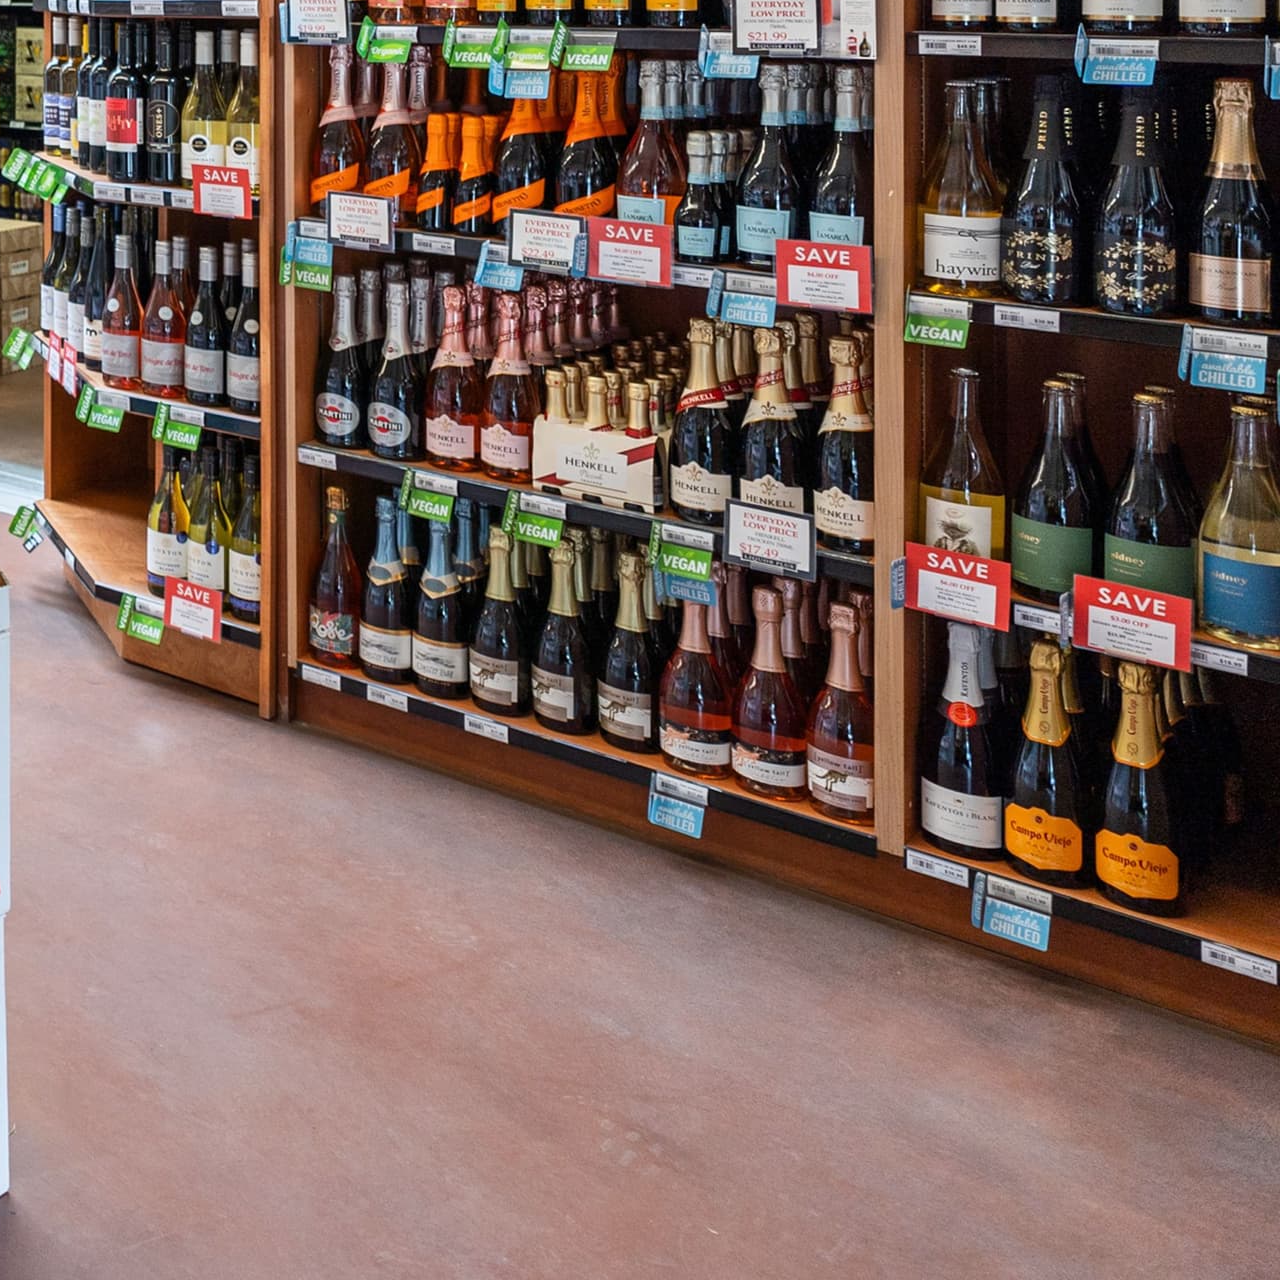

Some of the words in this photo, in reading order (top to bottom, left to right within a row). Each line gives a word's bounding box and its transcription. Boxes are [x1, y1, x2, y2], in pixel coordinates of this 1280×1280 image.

[750, 0, 805, 9] EVERYDAY
[750, 10, 771, 18] LOW
[776, 10, 806, 18] PRICE
[747, 31, 788, 42] $21.99
[371, 44, 405, 58] Organic
[454, 51, 491, 64] VEGAN
[566, 52, 609, 66] VEGAN
[709, 63, 752, 75] CHILLED
[1091, 70, 1147, 83] CHILLED
[203, 168, 239, 183] SAVE
[336, 224, 366, 235] $22.49
[525, 219, 572, 230] EVERYDAY
[521, 247, 555, 258] $22.49
[934, 258, 998, 278] haywire
[1106, 260, 1167, 273] FRIND
[1201, 362, 1257, 375] available
[679, 392, 716, 407] HENKELL
[318, 406, 353, 421] MARTINI
[166, 430, 197, 445] VEGAN
[739, 542, 779, 559] $17.49
[176, 582, 210, 604] SAVE
